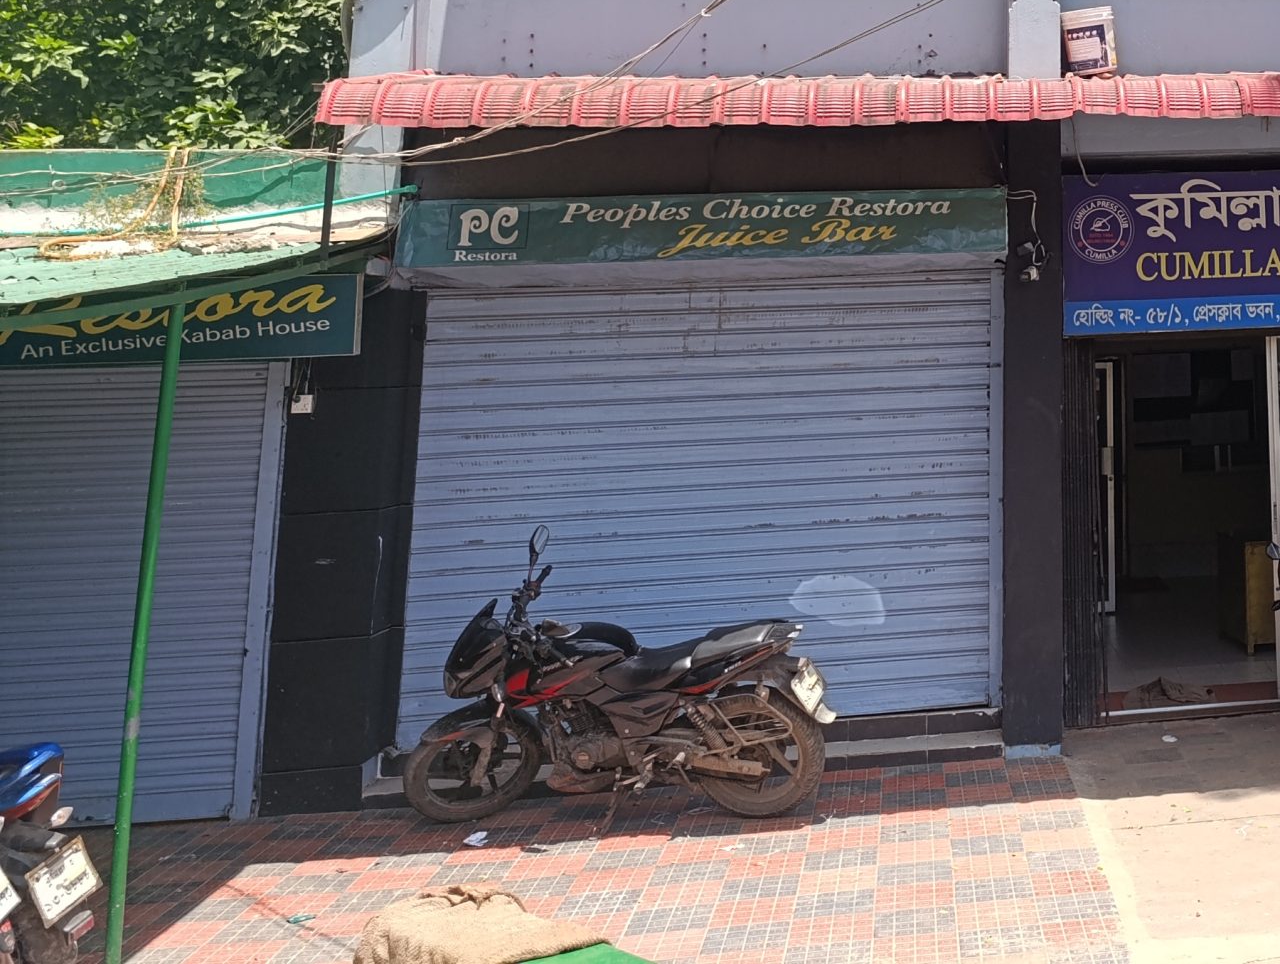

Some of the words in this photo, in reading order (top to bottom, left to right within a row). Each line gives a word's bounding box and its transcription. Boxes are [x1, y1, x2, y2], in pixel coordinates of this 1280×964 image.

[560, 201, 691, 229] Peoples
[702, 197, 816, 220] Choice
[828, 197, 951, 217] Restora
[454, 250, 517, 262] Restora
[657, 224, 789, 258] Juice
[801, 219, 898, 244] Bar
[0, 284, 336, 345] Resora
[1073, 303, 1115, 327] হোল্ডিং
[1146, 303, 1189, 327] ৫৮/১,
[1193, 303, 1241, 322] প্রেসক্লাব
[1245, 302, 1280, 323] ভবন,
[21, 344, 53, 360] An
[61, 335, 167, 356] Exclusive
[181, 324, 250, 344] Kabab
[257, 319, 330, 337] House
